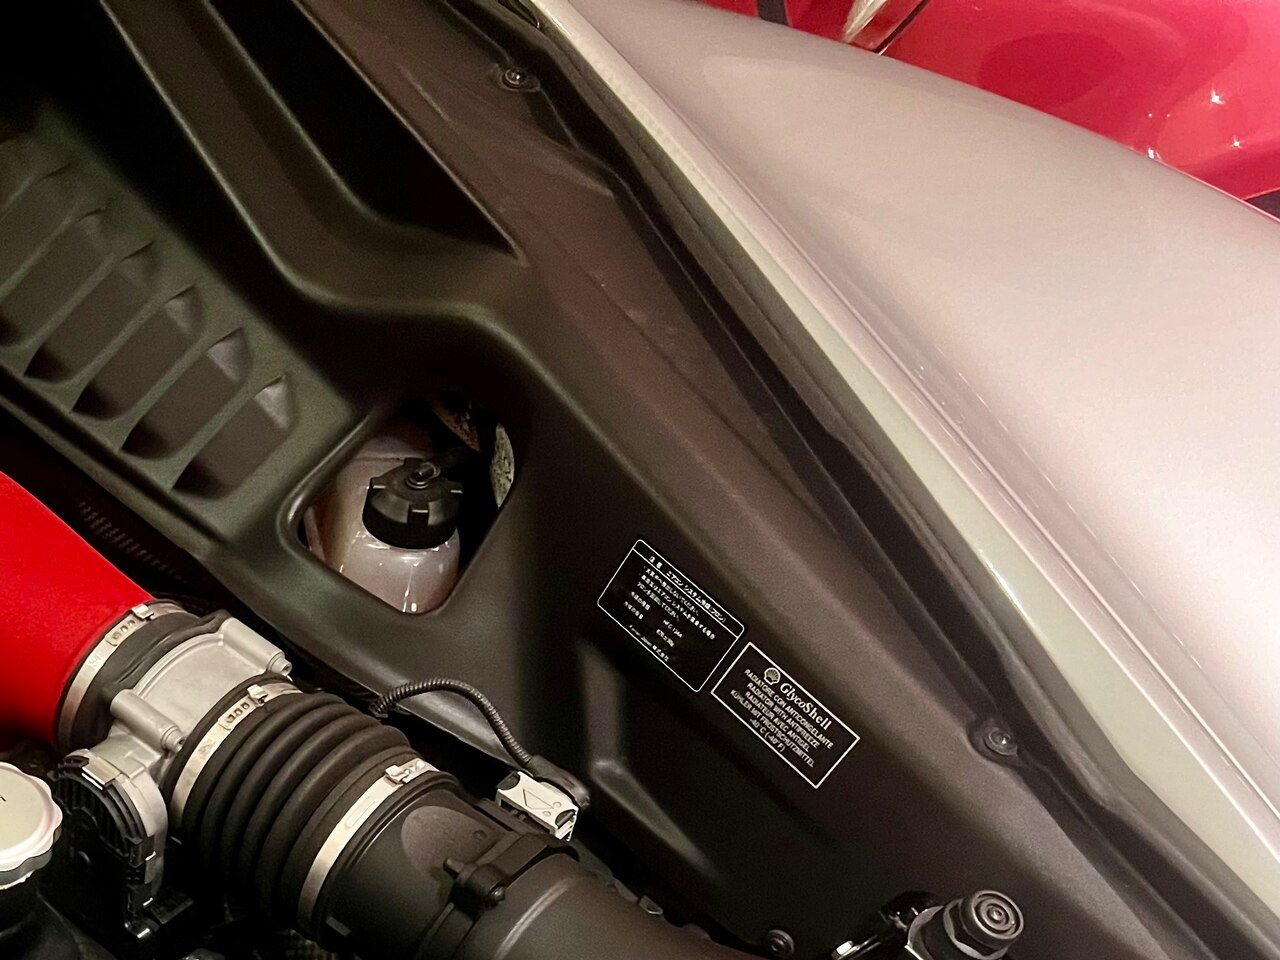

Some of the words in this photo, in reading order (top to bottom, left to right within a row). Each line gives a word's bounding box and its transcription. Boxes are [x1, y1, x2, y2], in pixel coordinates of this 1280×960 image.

[744, 668, 775, 697] RADIATORE
[773, 694, 786, 708] CON
[784, 705, 833, 749] ANTICONGELANTE
[744, 691, 774, 719] RADIATEUR
[772, 717, 788, 731] AVEC
[786, 729, 810, 753] ANTIGEL
[746, 682, 774, 707] RADIATOR
[772, 704, 788, 720] WITH
[785, 717, 820, 748] ANTIFREEZE
[750, 707, 762, 718] MIT
[759, 715, 814, 767] FROSTSCHUTZMITTEL
[779, 682, 831, 730] GlycoShell
